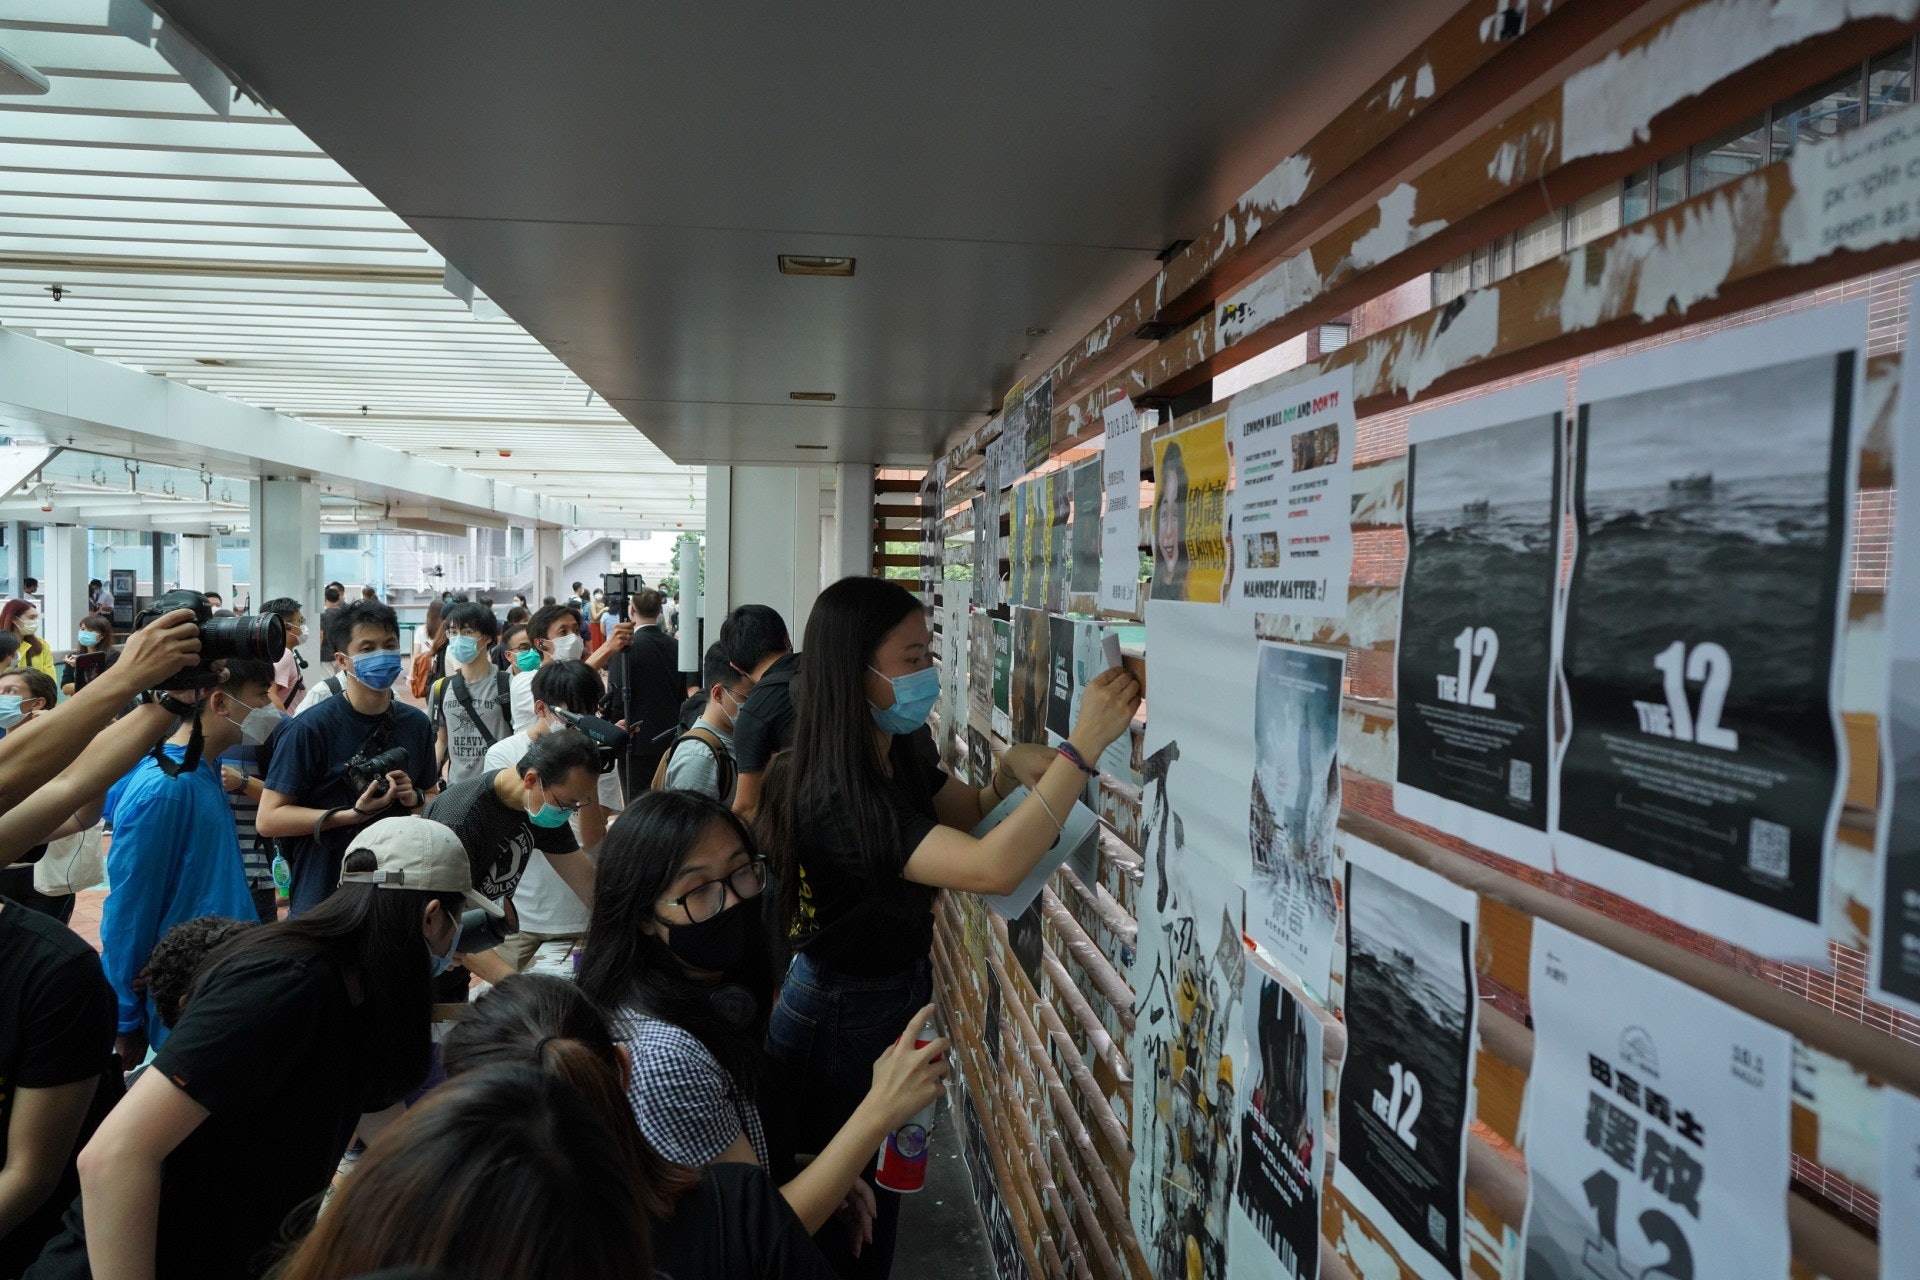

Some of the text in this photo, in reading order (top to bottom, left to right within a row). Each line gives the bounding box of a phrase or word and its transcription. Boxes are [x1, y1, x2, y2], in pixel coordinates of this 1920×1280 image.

[1244, 580, 1278, 598] MANNERS
[1279, 580, 1317, 600] MATTER
[1437, 626, 1499, 710] THE 12
[1632, 640, 1738, 751] THE 12
[453, 747, 488, 757] LIFTING
[454, 736, 483, 746] HEAVY
[1387, 1061, 1422, 1151] 12
[1248, 1100, 1313, 1185] RESISTANCE
[1252, 1131, 1303, 1202] REVOLUTION
[1261, 1161, 1292, 1208] REVENGE
